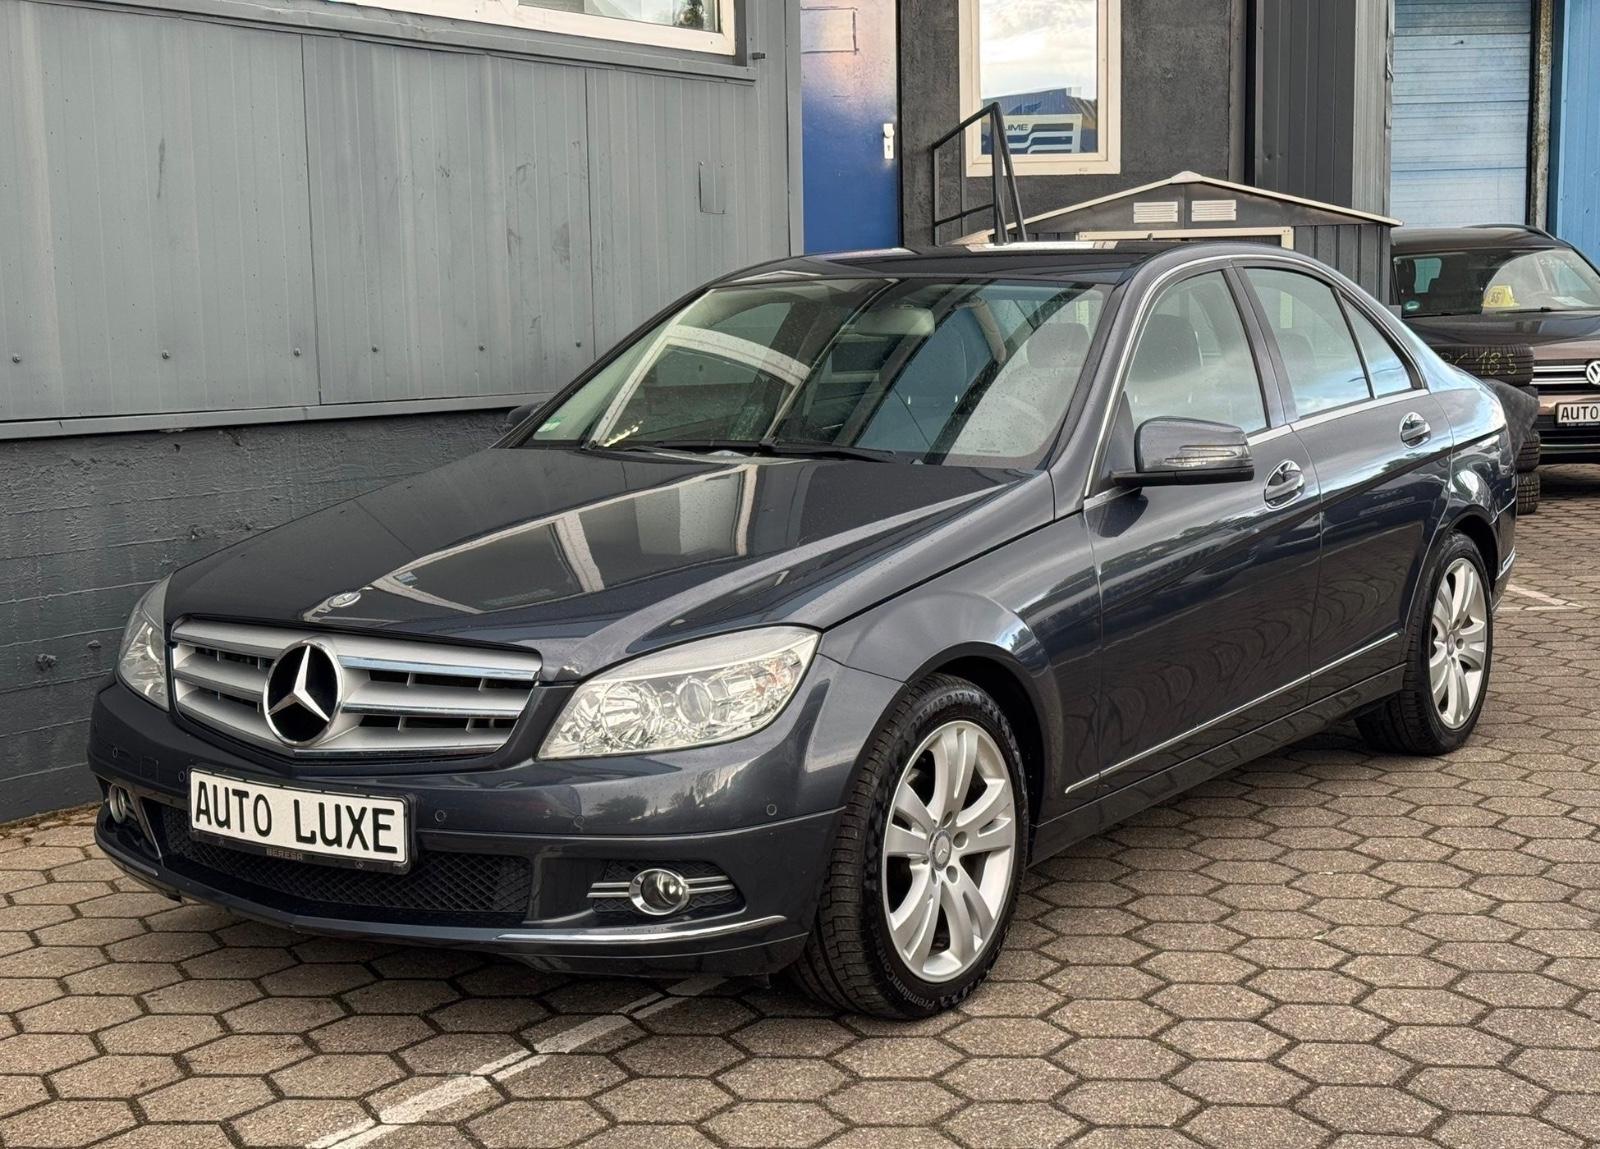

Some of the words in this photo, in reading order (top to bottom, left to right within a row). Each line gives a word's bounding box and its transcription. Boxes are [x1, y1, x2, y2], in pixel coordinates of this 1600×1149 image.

[1561, 406, 1599, 420] AUTO
[195, 780, 272, 837] AUTO
[293, 799, 398, 854] LUXE
